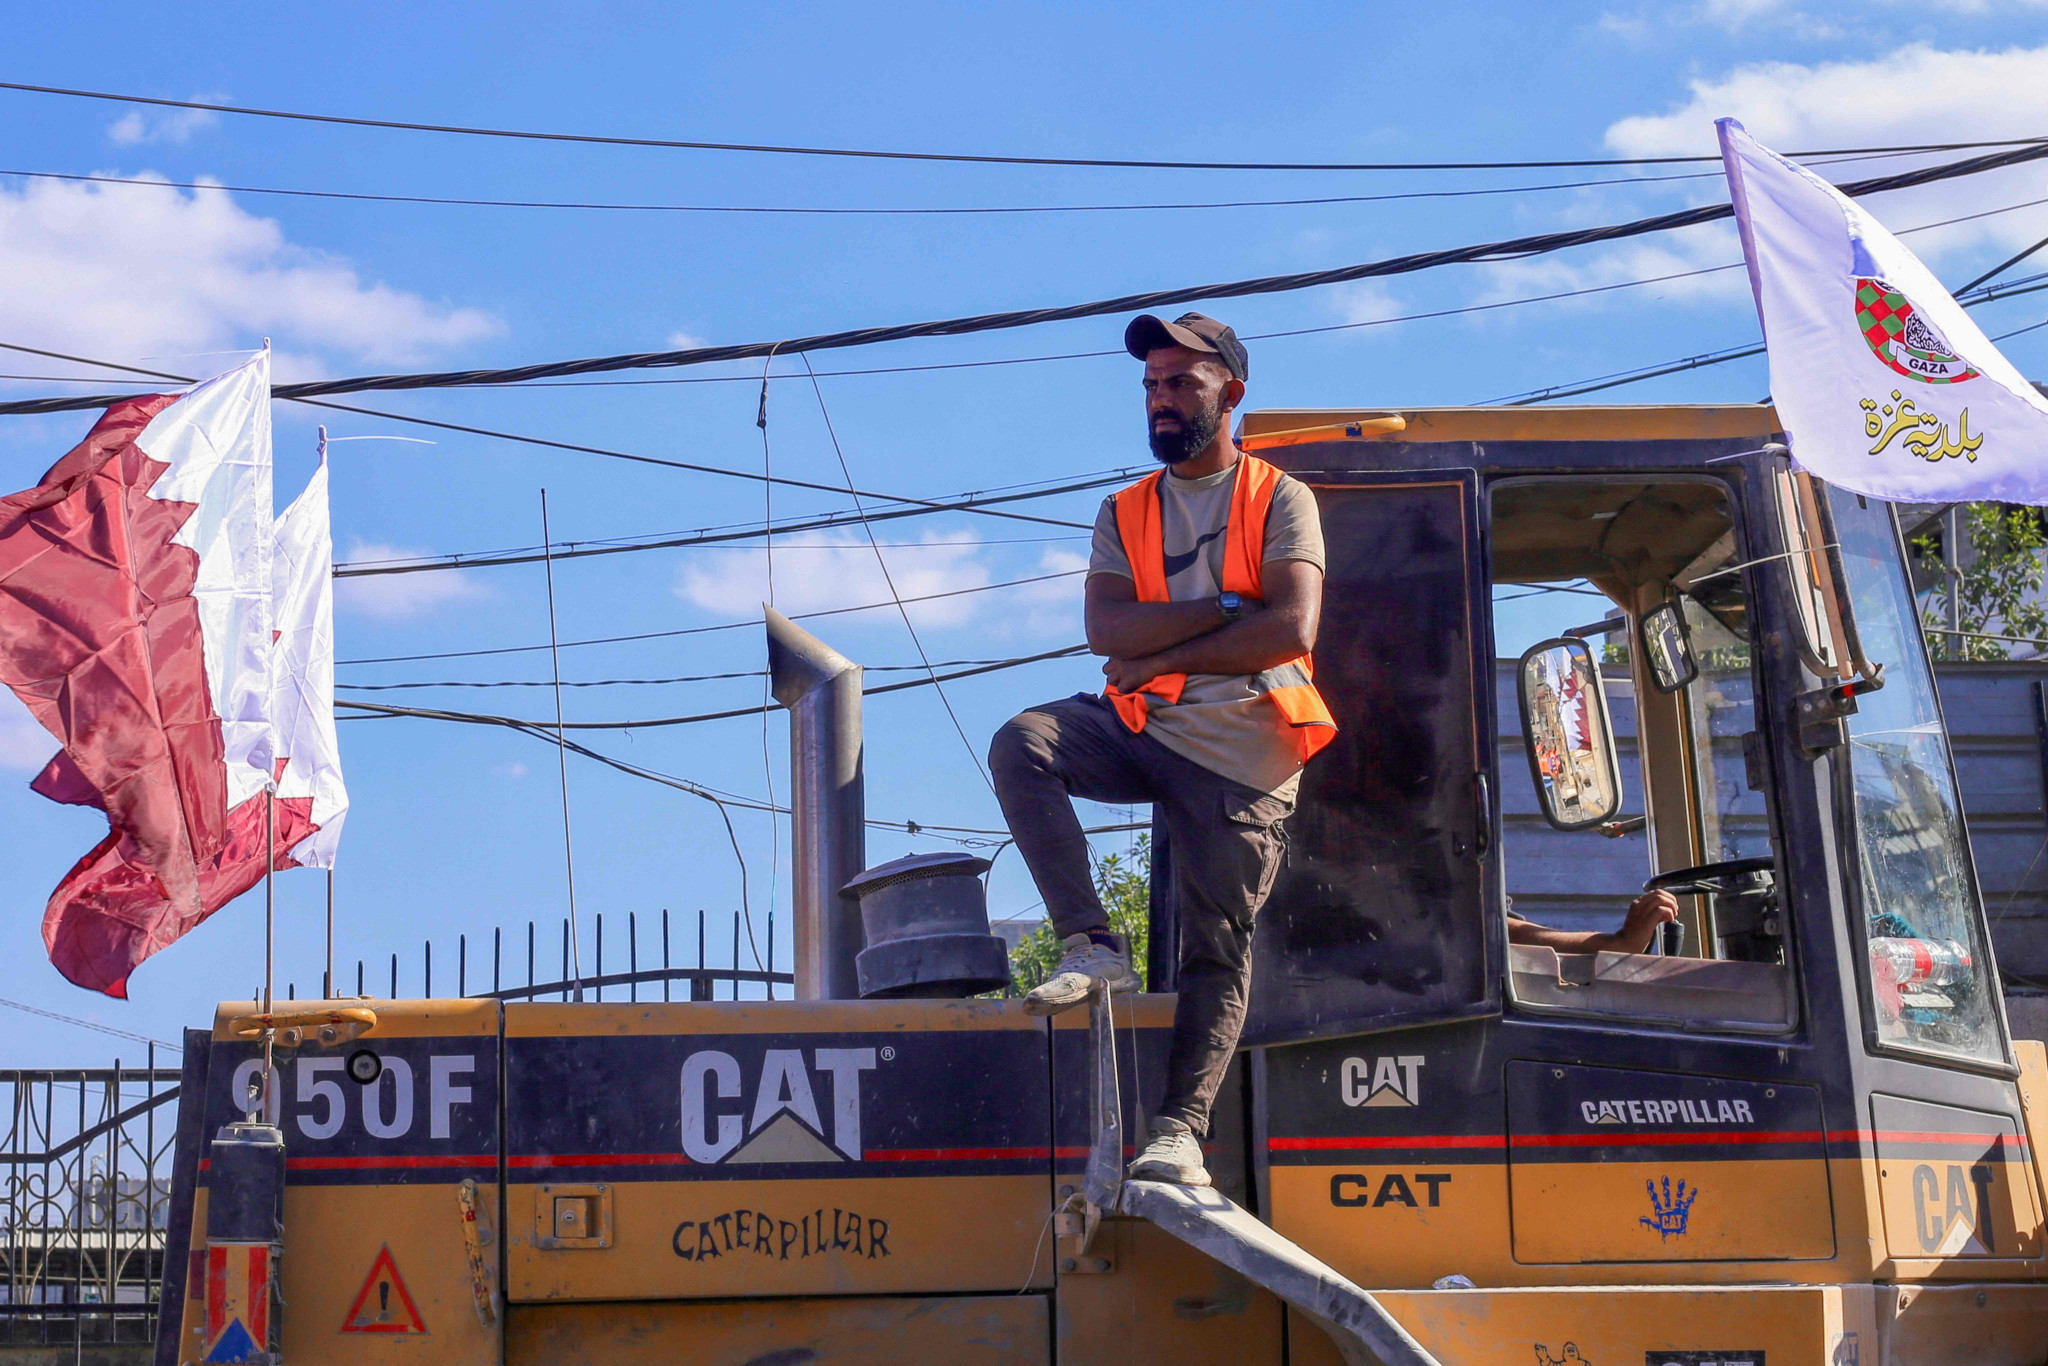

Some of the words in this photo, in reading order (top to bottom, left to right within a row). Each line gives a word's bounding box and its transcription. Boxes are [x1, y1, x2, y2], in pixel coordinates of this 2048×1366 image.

[1909, 359, 1949, 374] GAZA
[1859, 389, 1920, 456] غزة
[1903, 407, 1984, 463] بلدية
[232, 1055, 475, 1140] 950F
[1341, 1055, 1425, 1107] CAT
[1581, 1099, 1754, 1124] CATERPILLAR
[1330, 1173, 1452, 1208] CAT
[1912, 1164, 1995, 1254] CAT
[672, 1208, 892, 1262] CATERPILLAR
